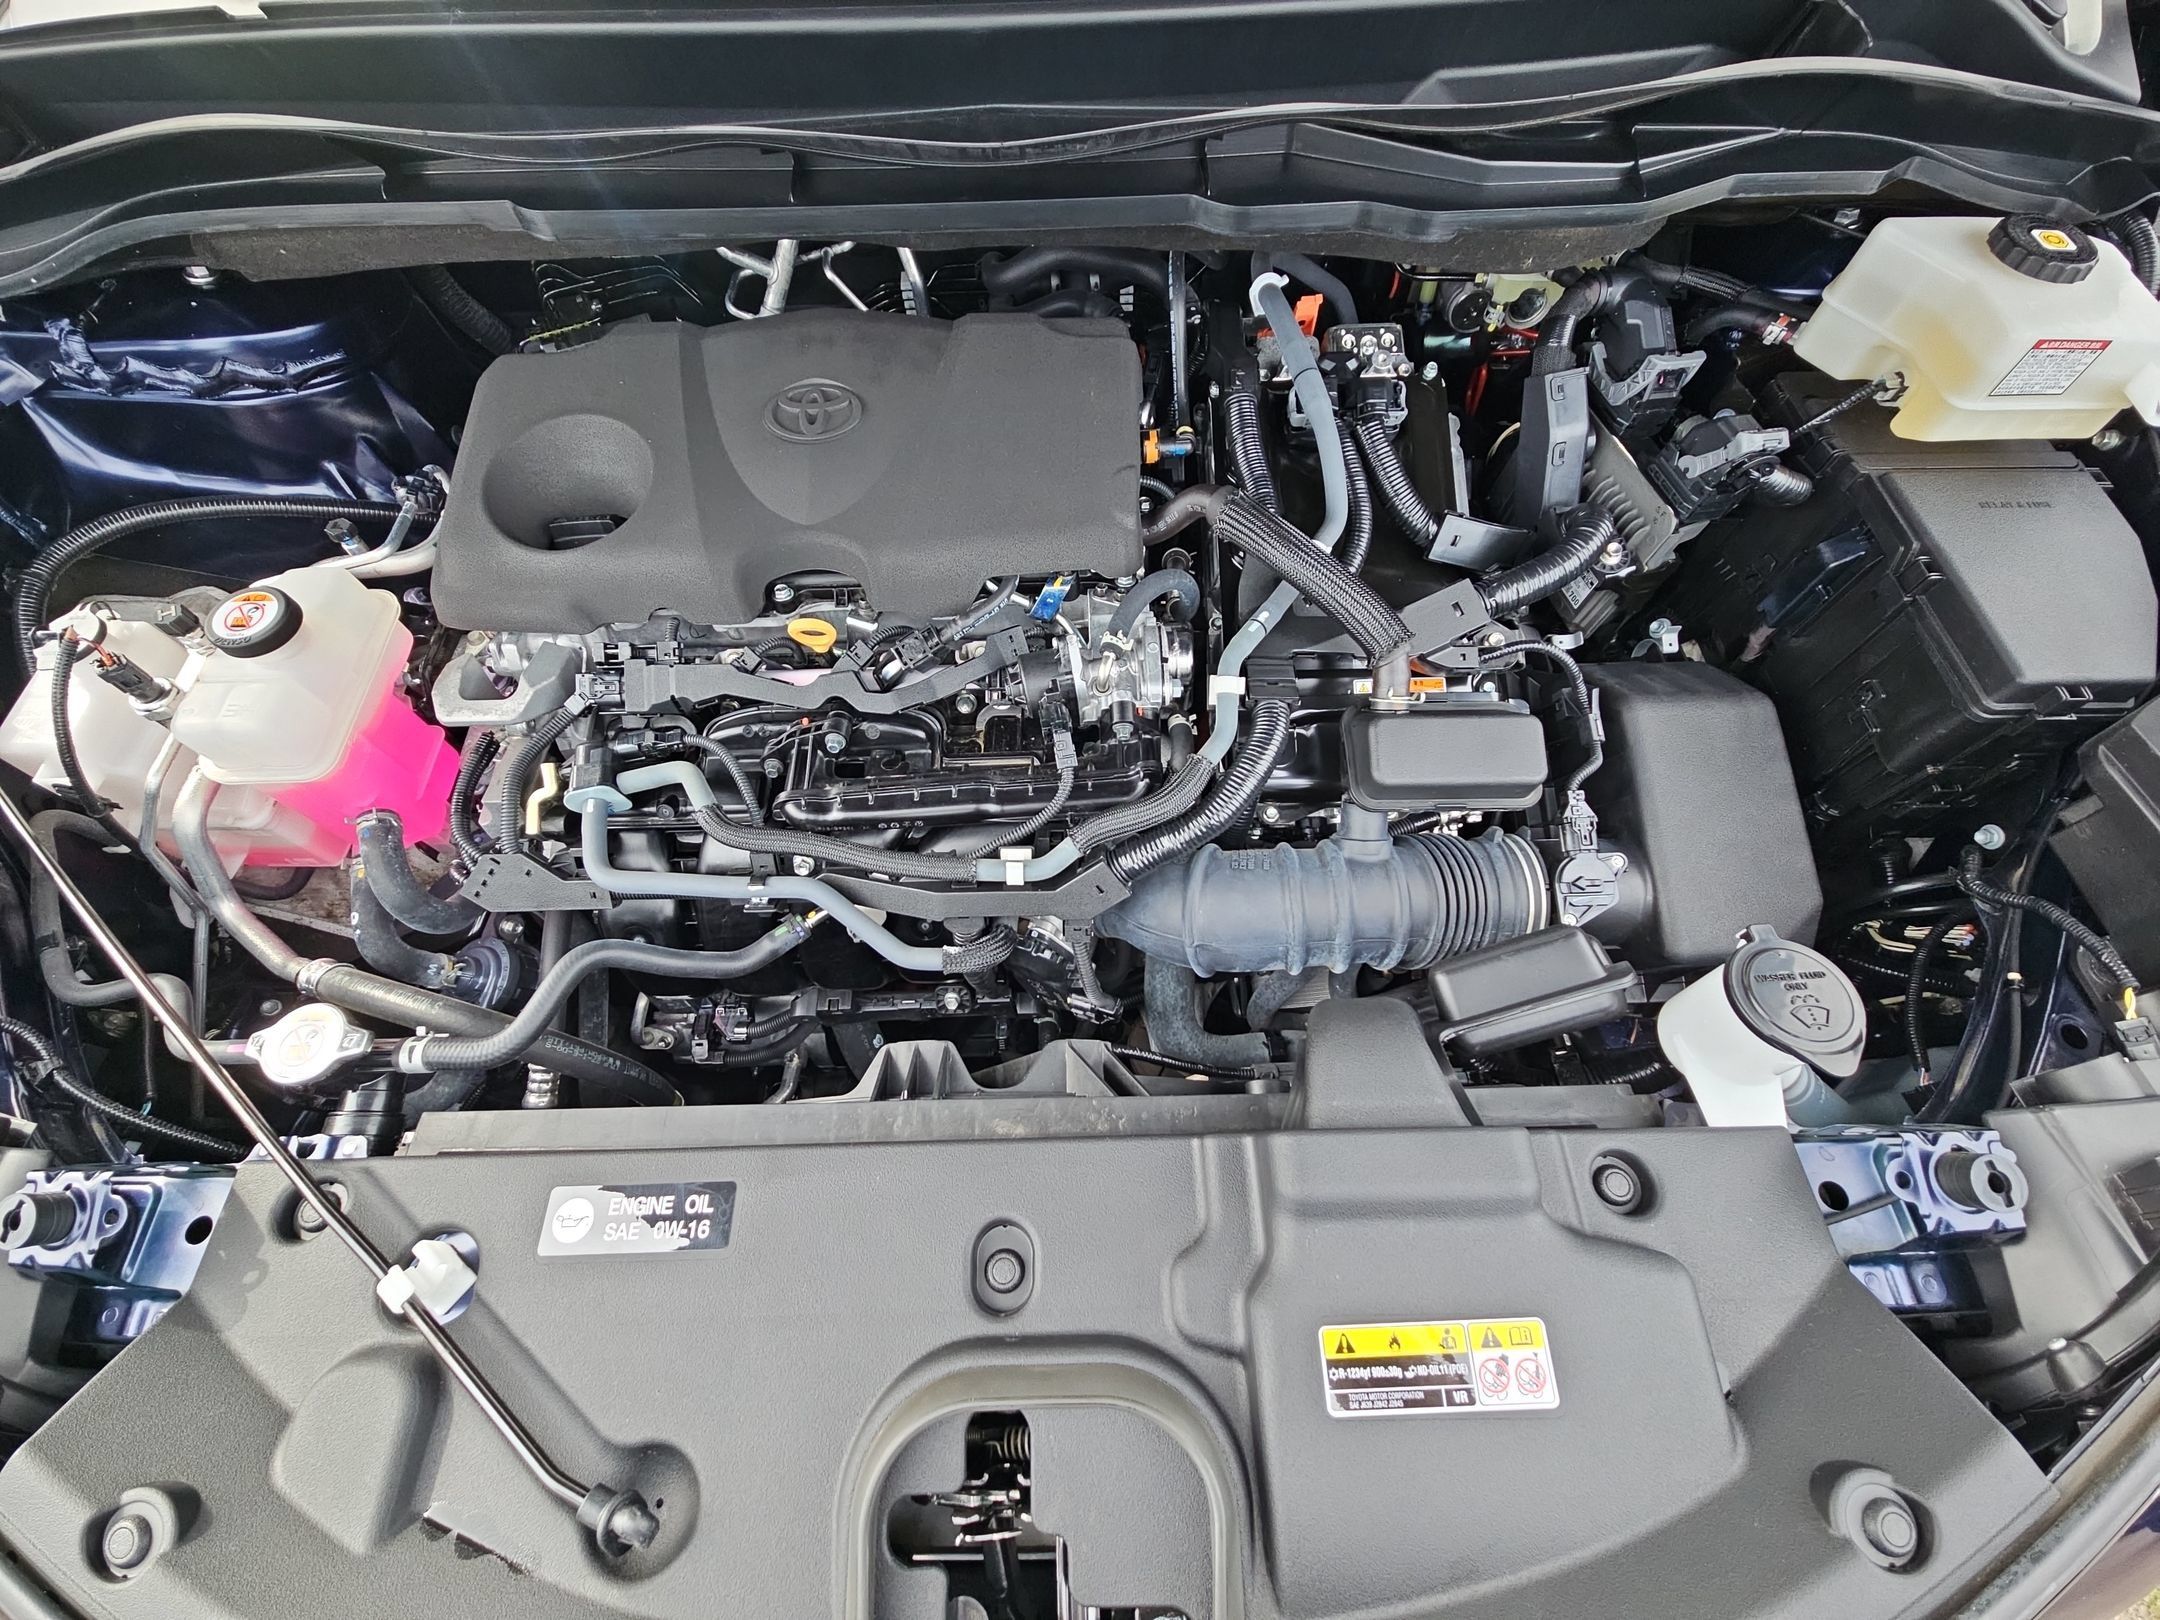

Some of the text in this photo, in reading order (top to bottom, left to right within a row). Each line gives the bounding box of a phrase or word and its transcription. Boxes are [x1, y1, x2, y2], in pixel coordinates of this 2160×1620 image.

[1753, 971, 1827, 982] WASHER FLUID
[1783, 982, 1808, 991] ONLY
[608, 1194, 714, 1215] ENGINE OIL
[603, 1219, 711, 1241] SAE 0W-16
[1348, 1390, 1425, 1401] TOYOTA MOTOR CORPORATION
[1453, 1390, 1469, 1404] VR
